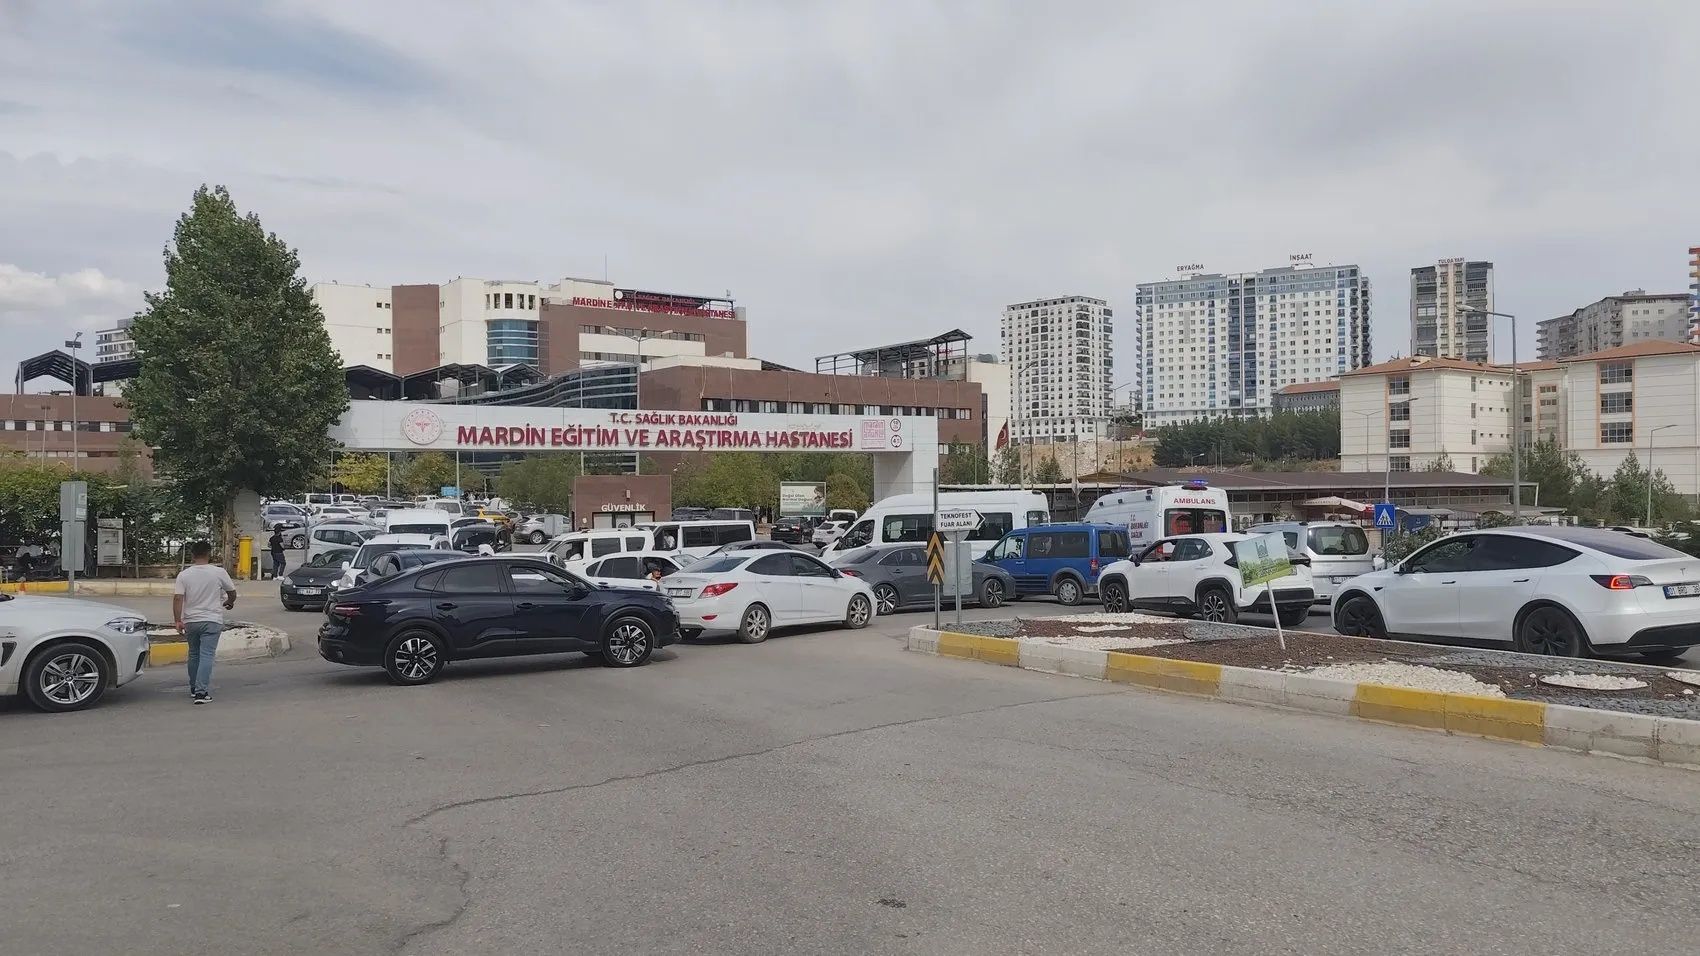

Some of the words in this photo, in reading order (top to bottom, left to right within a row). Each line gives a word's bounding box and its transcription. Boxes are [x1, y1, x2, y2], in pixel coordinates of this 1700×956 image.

[1176, 263, 1204, 272] ERYAĞMA
[1289, 253, 1313, 261] İNŞAAT
[573, 296, 607, 308] MARDİN
[610, 412, 632, 424] T.C.
[635, 411, 676, 425] SAĞLIK
[678, 413, 738, 426] BAKANLIĞI
[457, 423, 546, 446] MARDİN
[551, 424, 619, 447] EĞİTİM
[624, 429, 650, 447] VE
[654, 430, 765, 450] ARAŞTIRMA
[765, 429, 853, 448] HASTANESİ
[601, 502, 646, 511] GÜVENLİK
[1173, 497, 1216, 505] AMBULANS
[940, 512, 972, 520] TEKNOFEST
